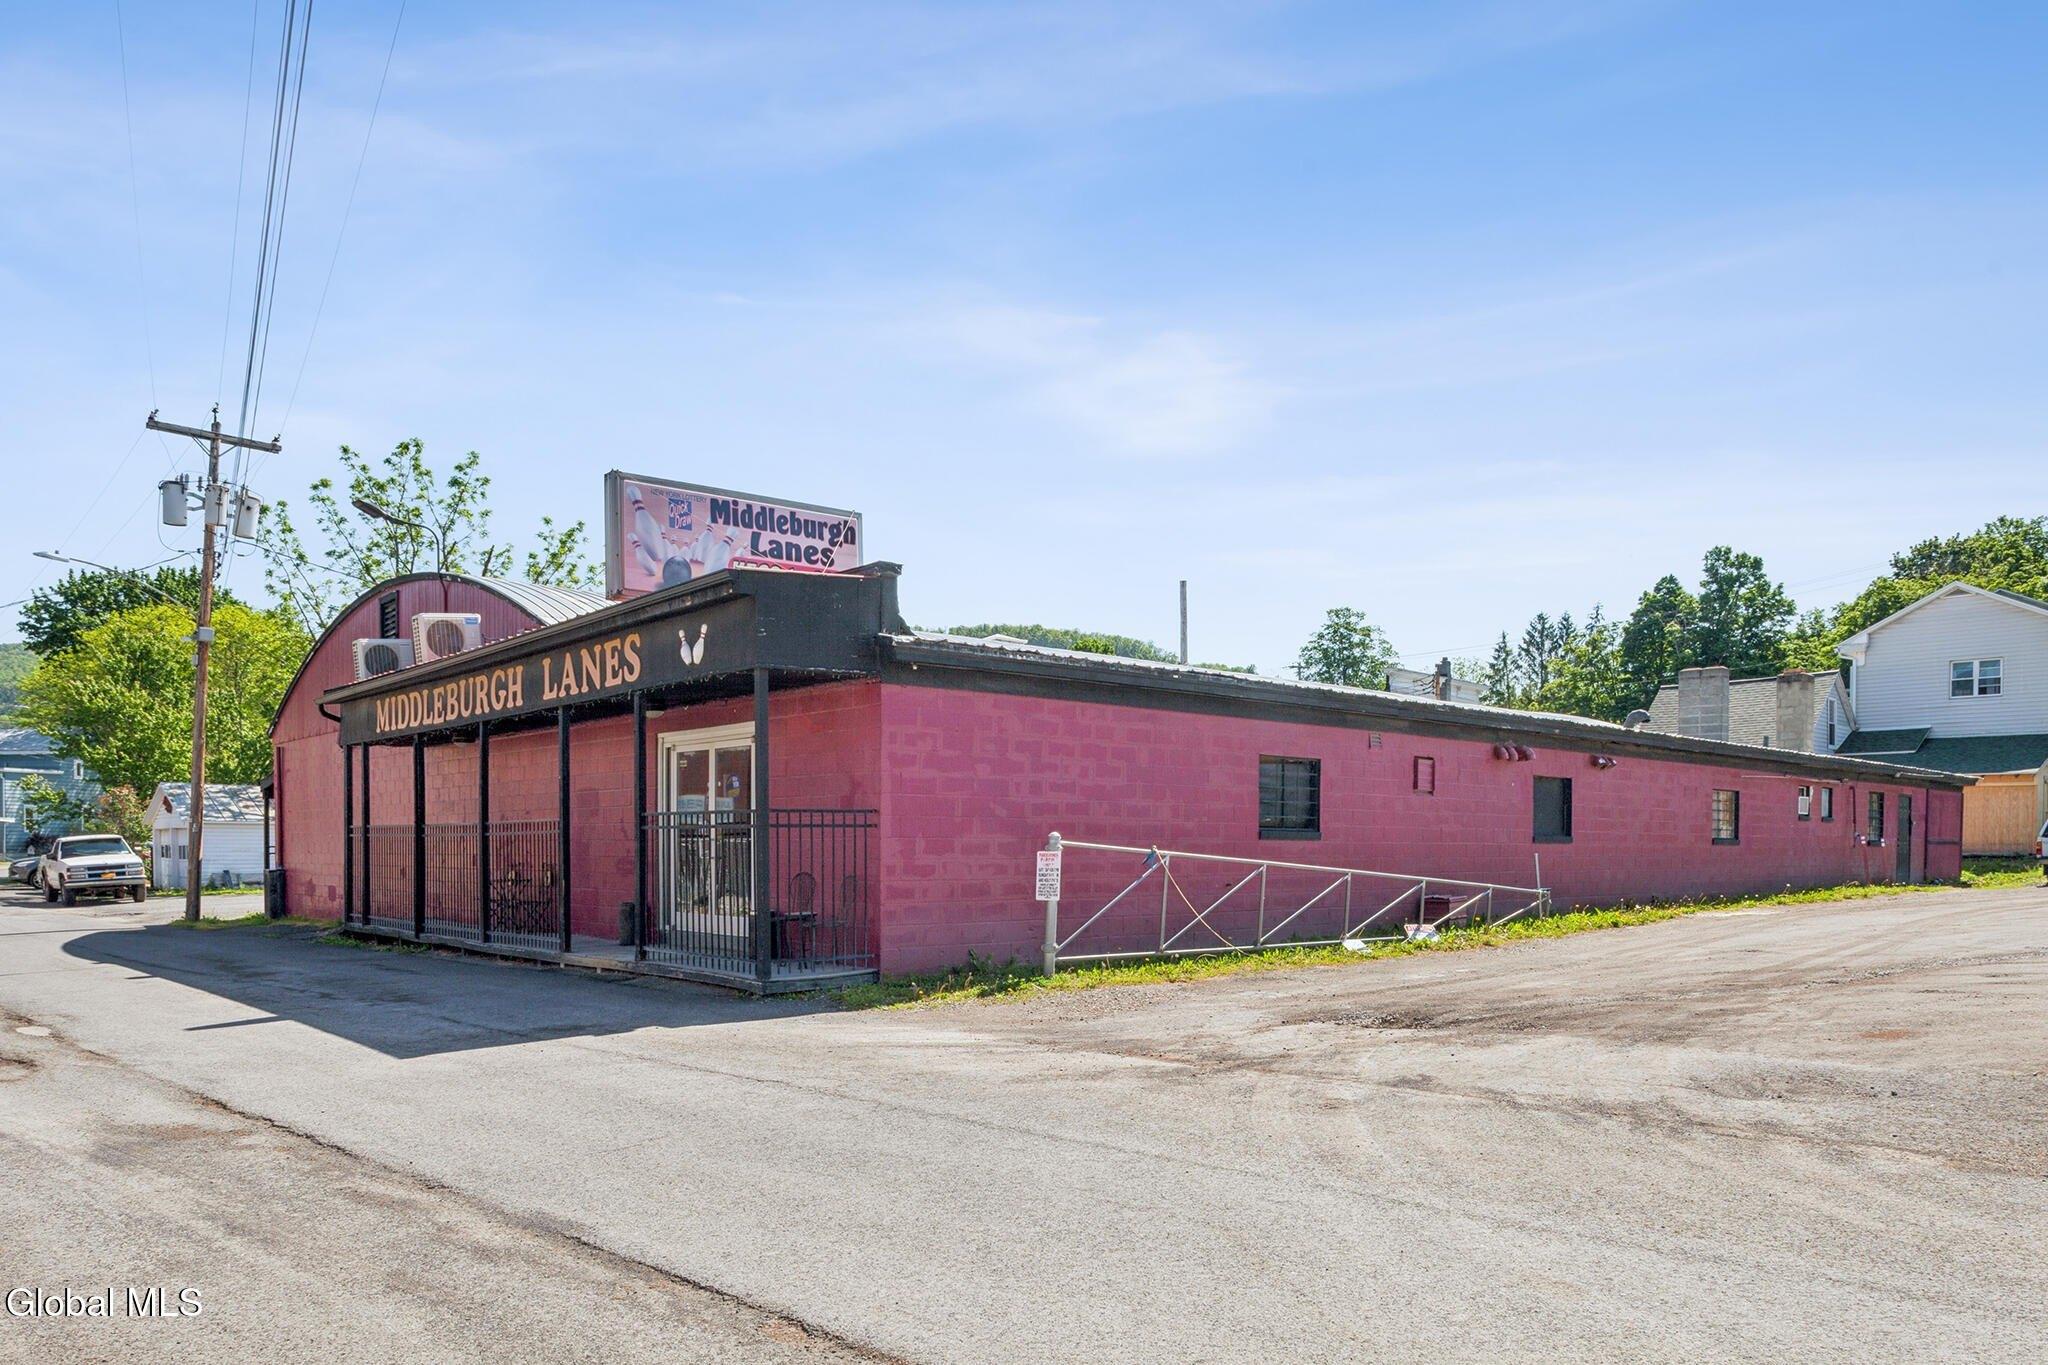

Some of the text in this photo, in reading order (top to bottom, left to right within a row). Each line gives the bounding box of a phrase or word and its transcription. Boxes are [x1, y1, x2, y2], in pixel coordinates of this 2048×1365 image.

[710, 498, 856, 548] Middleburgh
[750, 531, 836, 568] Lanes
[375, 633, 642, 734] MIDDLEBURGH LANES
